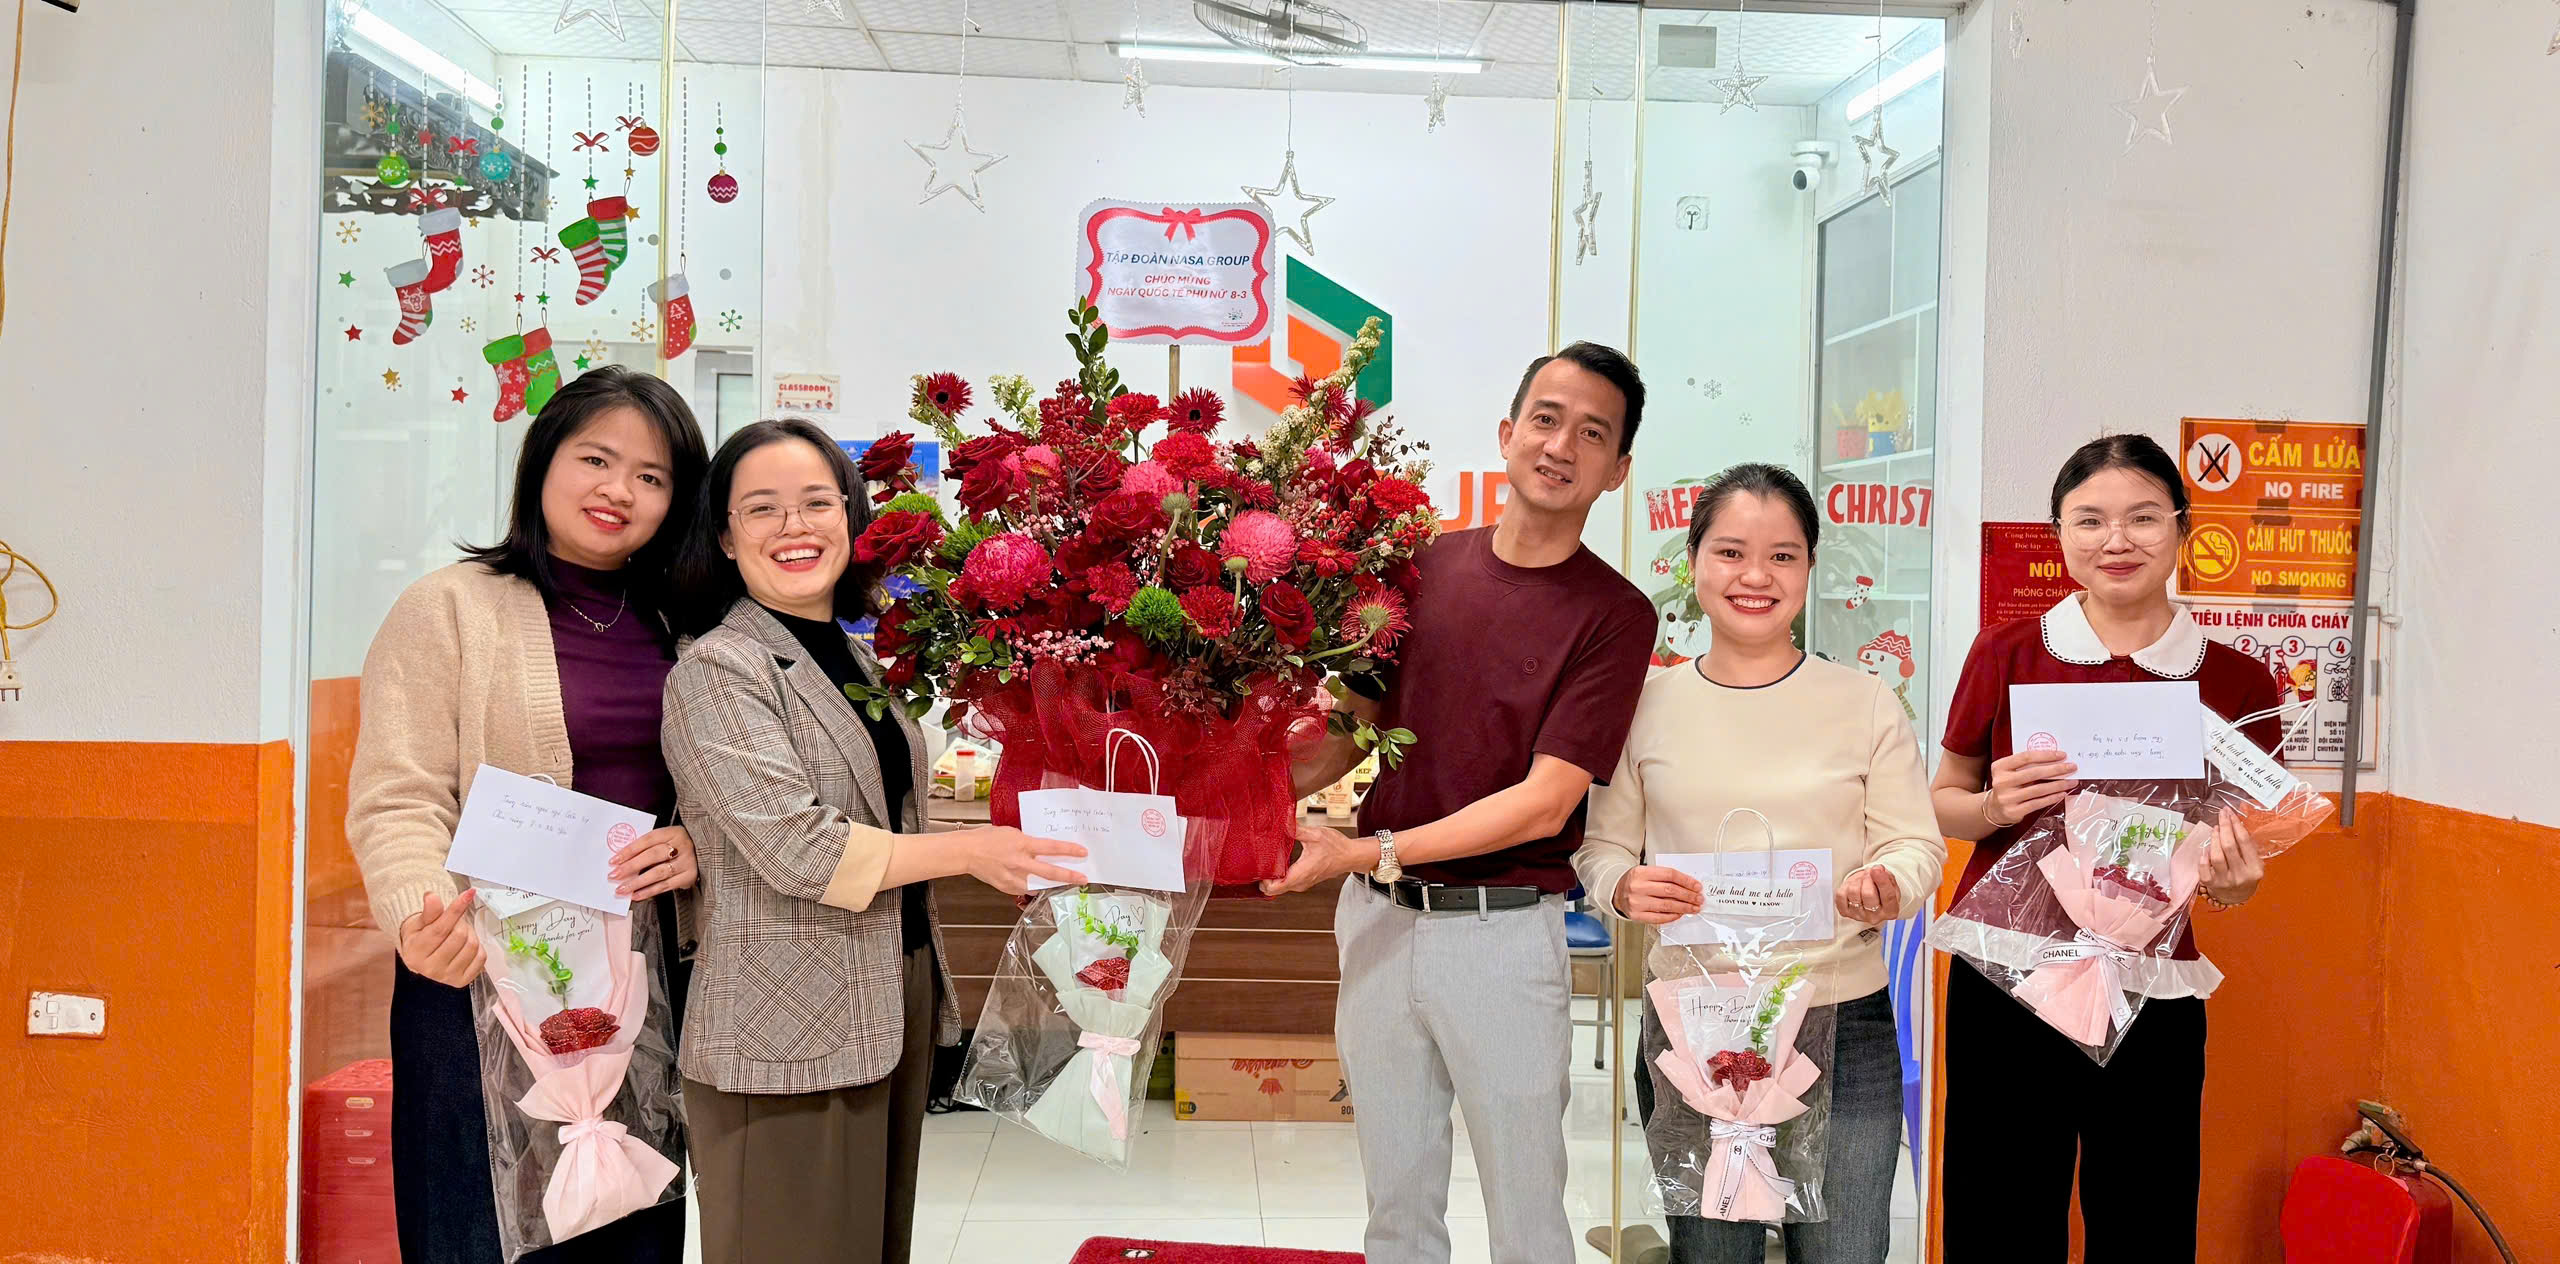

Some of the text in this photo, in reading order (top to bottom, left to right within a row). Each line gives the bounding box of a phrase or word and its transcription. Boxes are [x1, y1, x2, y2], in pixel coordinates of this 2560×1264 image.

[1170, 255, 1204, 265] NASA
[1207, 255, 1250, 266] GROUP
[1231, 291, 1247, 299] 8-3
[2249, 435, 2361, 470] CẤM LỬA
[2265, 482, 2344, 500] NO FIRE
[2247, 520, 2353, 555] CẤM HÚT THUỐC
[2029, 559, 2062, 581] NỘI
[2251, 570, 2347, 588] NO SMOKING
[2013, 586, 2044, 598] PHÒNG
[2045, 586, 2070, 598] CHÁY
[2191, 609, 2350, 630] TIÊU LỆNH CHỮA CHÁY
[2241, 638, 2251, 652] 2
[2288, 639, 2298, 654] 3
[2336, 641, 2346, 655] 4
[2226, 743, 2246, 757] had
[2242, 757, 2255, 767] me
[2263, 773, 2282, 790] hello
[1707, 884, 1794, 899] You had me at hello
[541, 906, 576, 932] Day
[2042, 949, 2081, 960] CHANEL
[1686, 995, 1723, 1016] Happy
